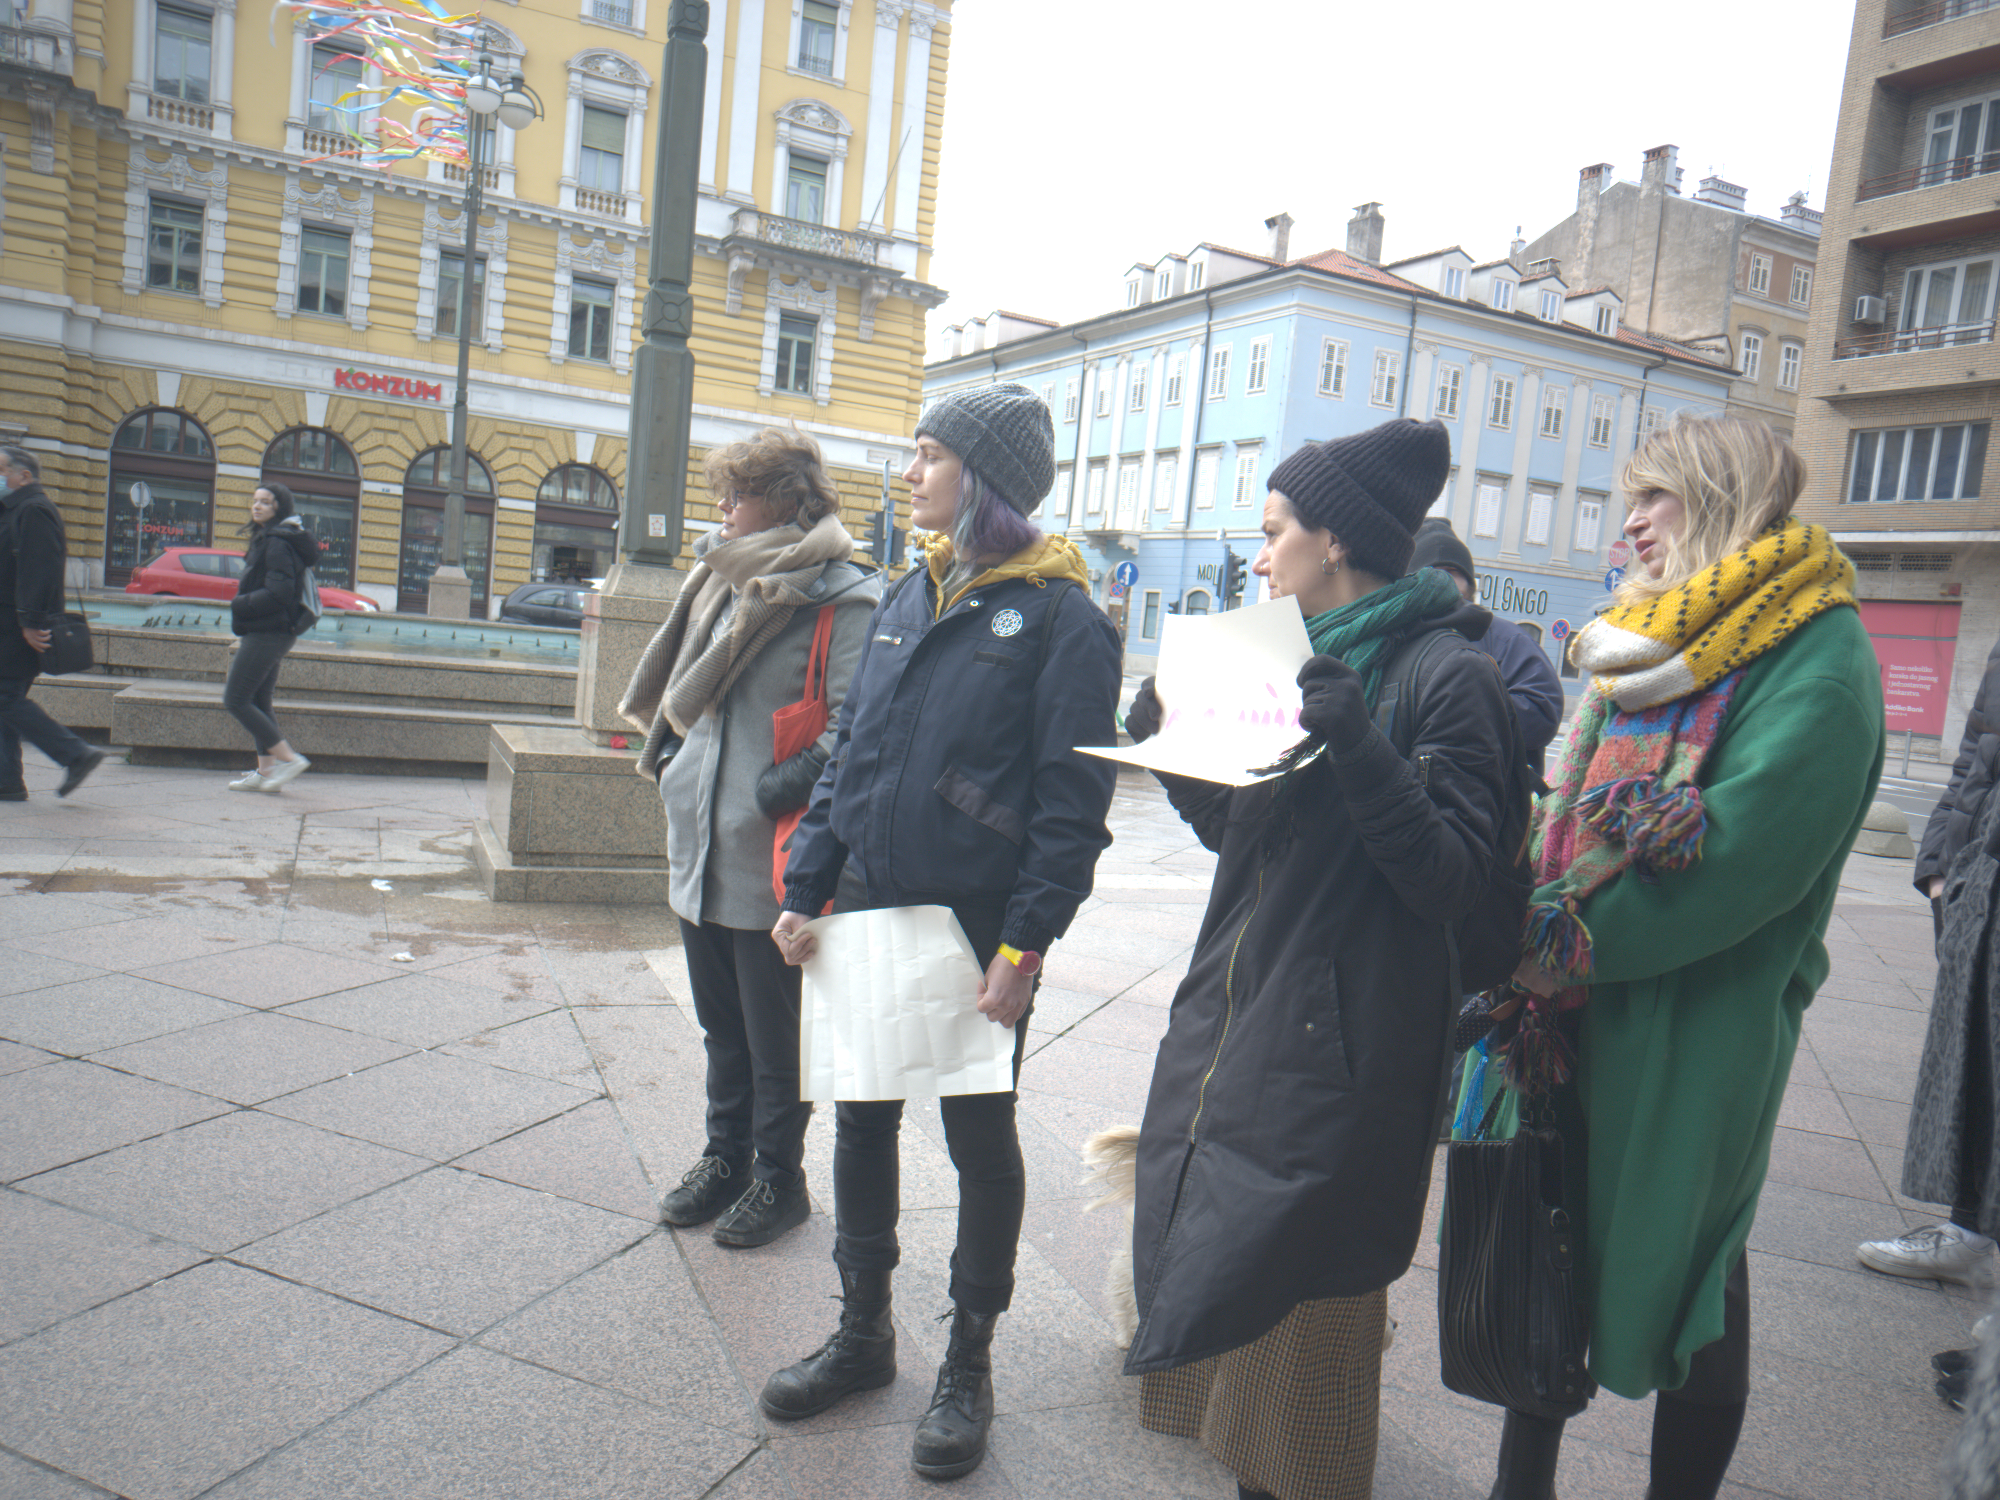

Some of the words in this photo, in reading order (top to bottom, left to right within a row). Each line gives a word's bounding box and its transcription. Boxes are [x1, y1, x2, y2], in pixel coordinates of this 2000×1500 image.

[335, 367, 441, 402] KONZUM
[1610, 547, 1630, 559] STOP
[1889, 672, 1909, 680] koraka
[1918, 675, 1939, 683] jasnog
[1891, 681, 1932, 691] jednostavnog
